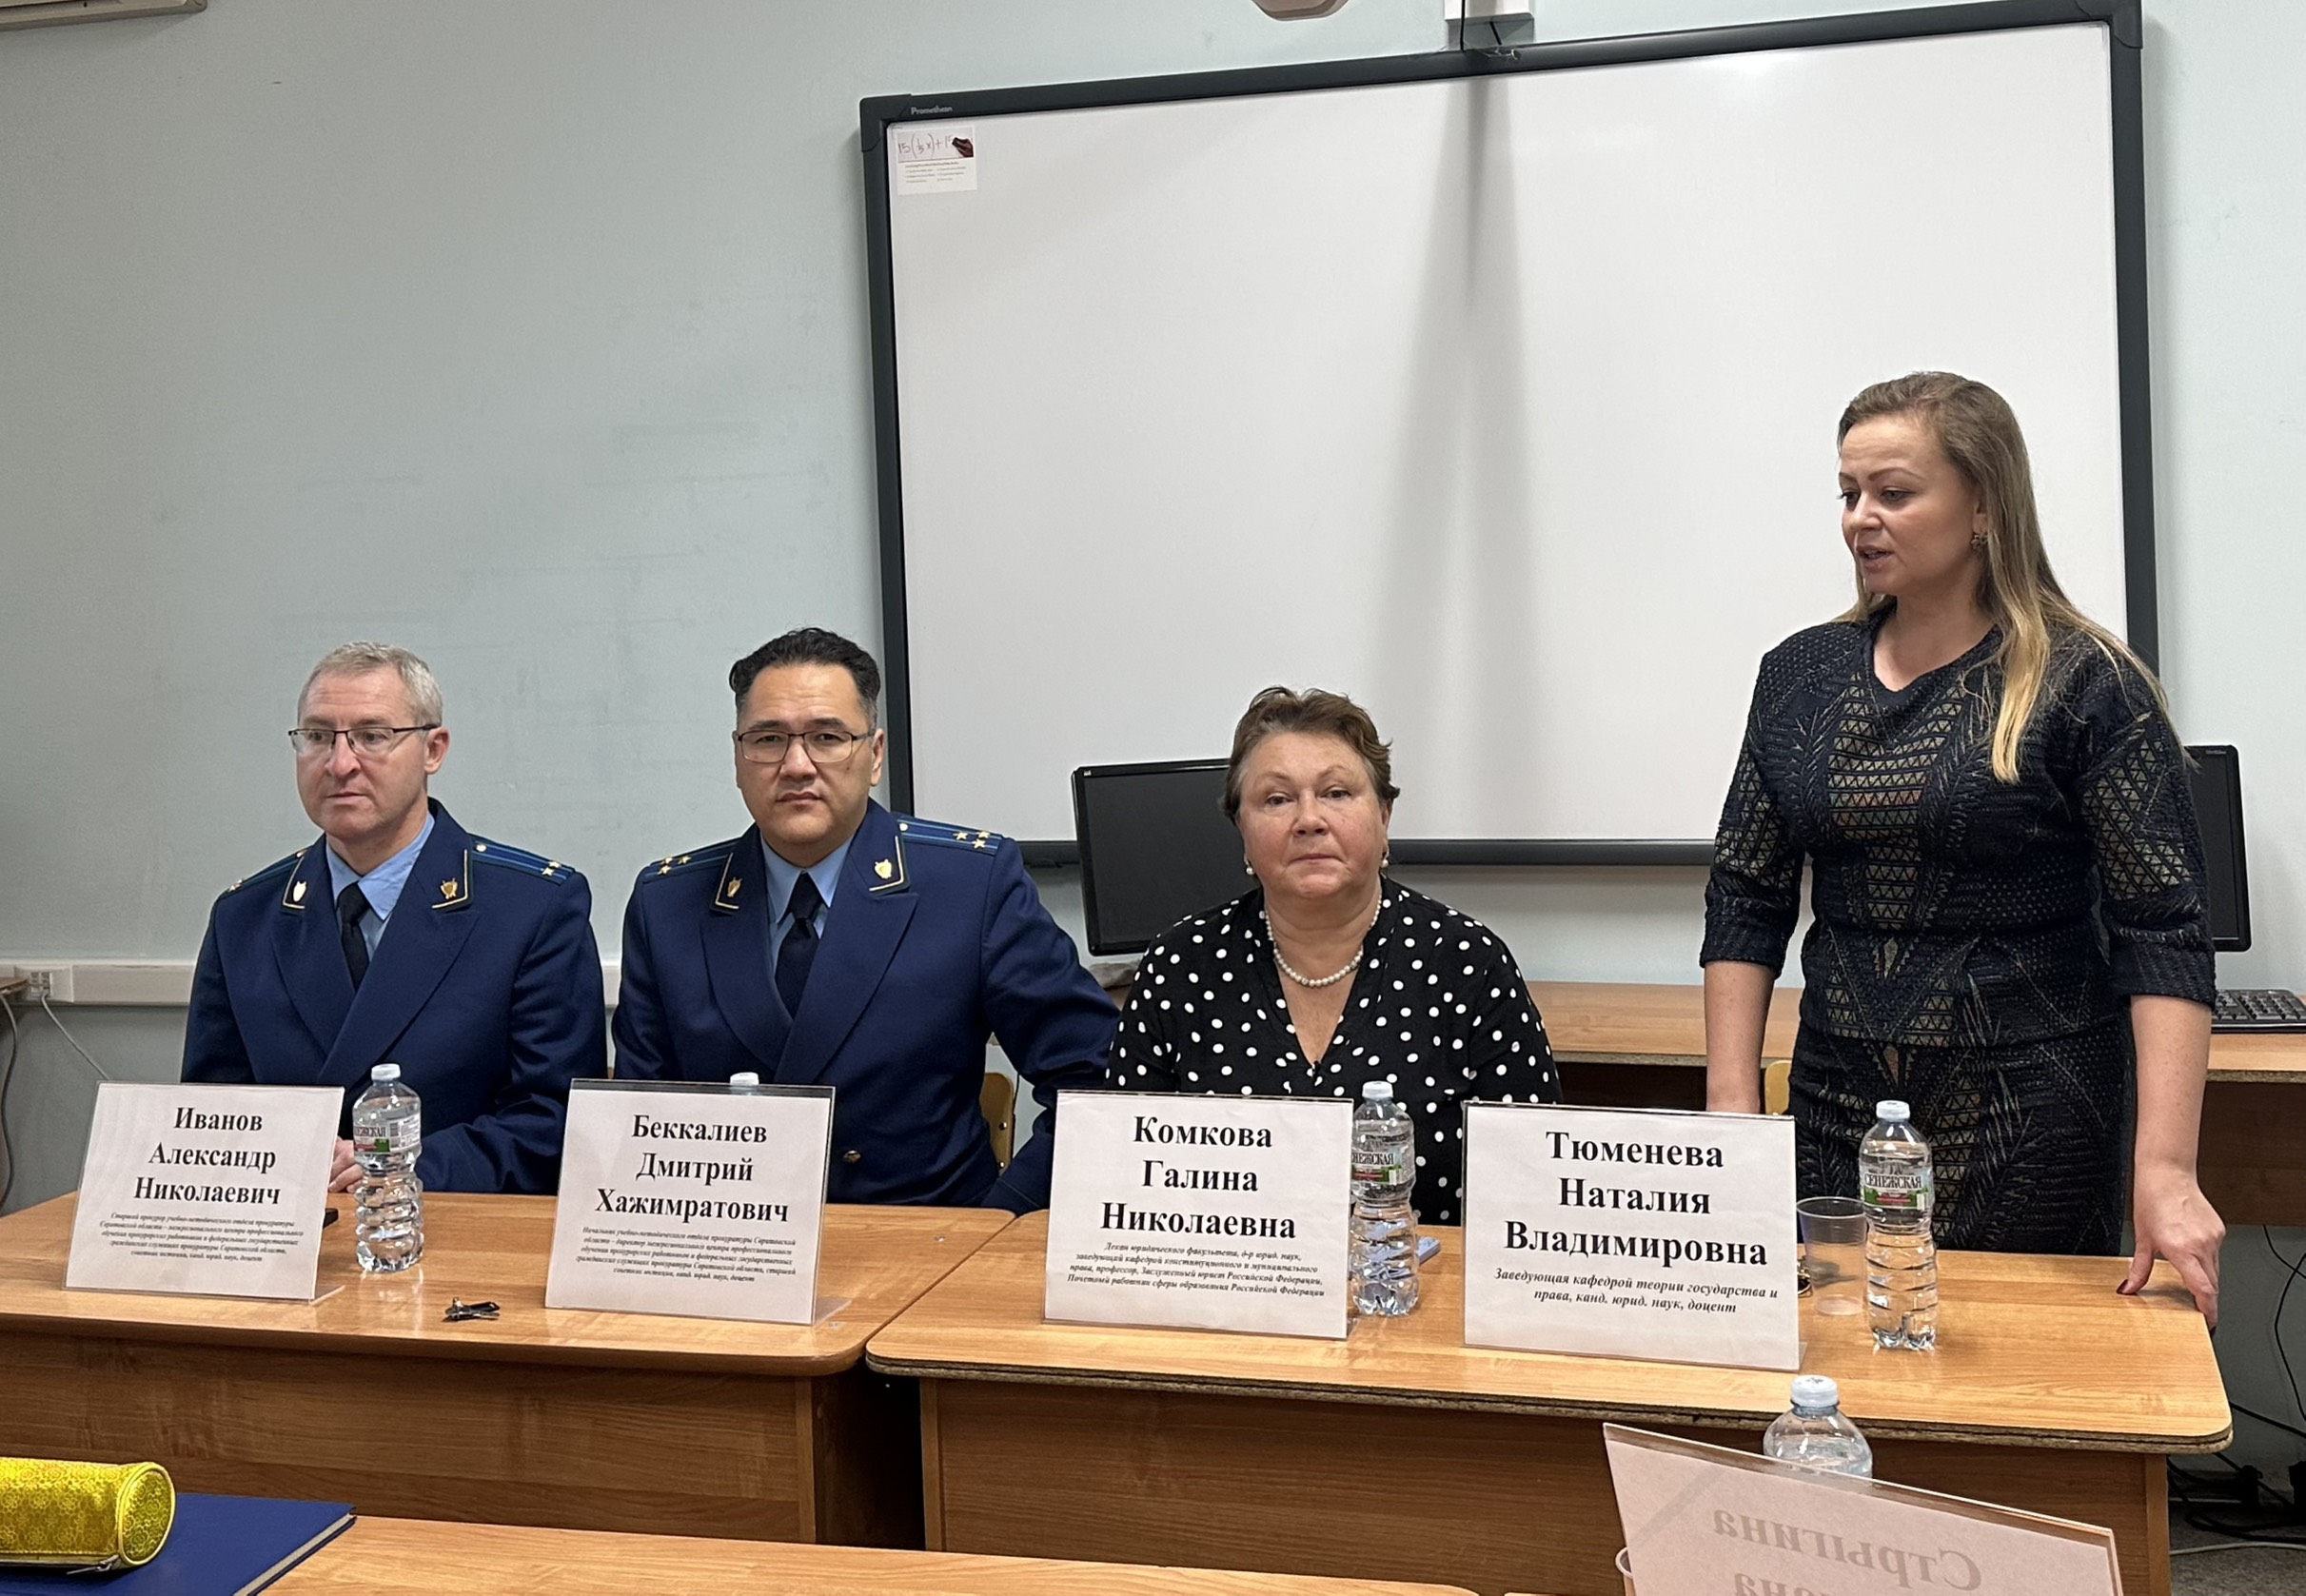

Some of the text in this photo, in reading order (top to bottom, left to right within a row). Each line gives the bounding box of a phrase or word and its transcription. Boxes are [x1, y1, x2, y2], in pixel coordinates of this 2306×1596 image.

[911, 105, 953, 115] Promethean
[173, 1107, 263, 1131] Иванов
[631, 1114, 767, 1143] Беккалиев
[1133, 1115, 1272, 1148] Комкова
[148, 1142, 276, 1173] Александр
[1546, 1131, 1725, 1168] Тюменева
[636, 1153, 753, 1186] Дмитрий
[1142, 1160, 1258, 1192] Галина
[1864, 1172, 1922, 1189] СЕНЕЖСКАЯ
[133, 1176, 281, 1205] Николаевич
[595, 1189, 789, 1223] Хажимратович
[1558, 1177, 1711, 1214] Наталия
[1100, 1202, 1296, 1239] Николаевна
[1504, 1220, 1767, 1268] Владимировна
[1494, 1268, 1778, 1298] Заведующая кафедрой теории государства и
[1534, 1291, 1737, 1313] права, канд. юрид. наук, доцент
